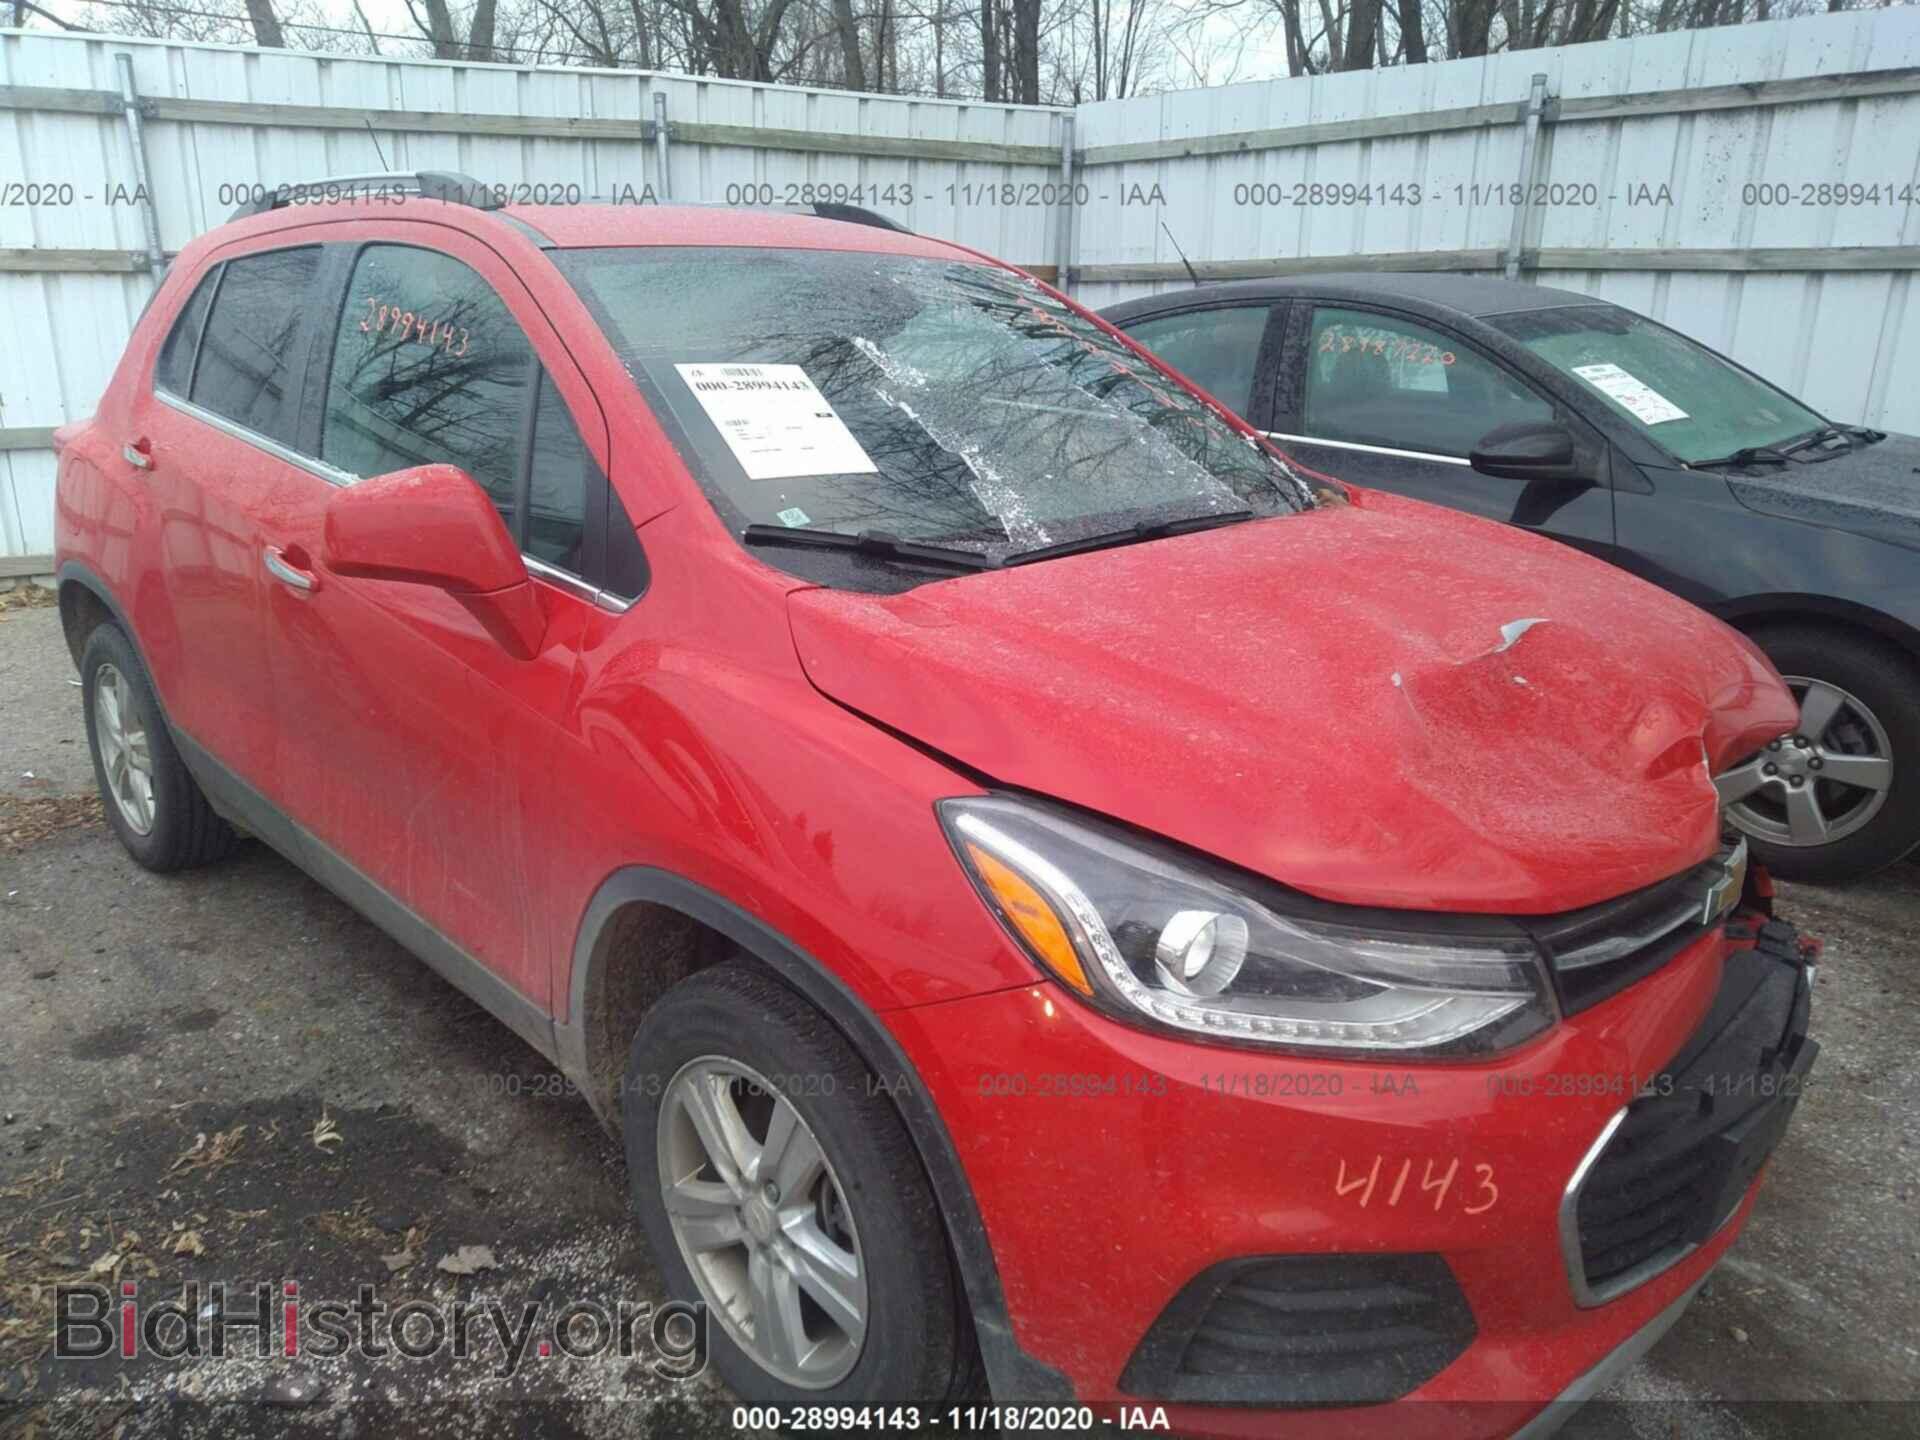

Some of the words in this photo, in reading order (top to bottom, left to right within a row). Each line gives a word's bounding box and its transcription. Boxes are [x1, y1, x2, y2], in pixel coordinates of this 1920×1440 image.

[359, 297, 470, 358] 28994143
[695, 380, 812, 392] 000-28994143
[1335, 1154, 1499, 1215] 4143
